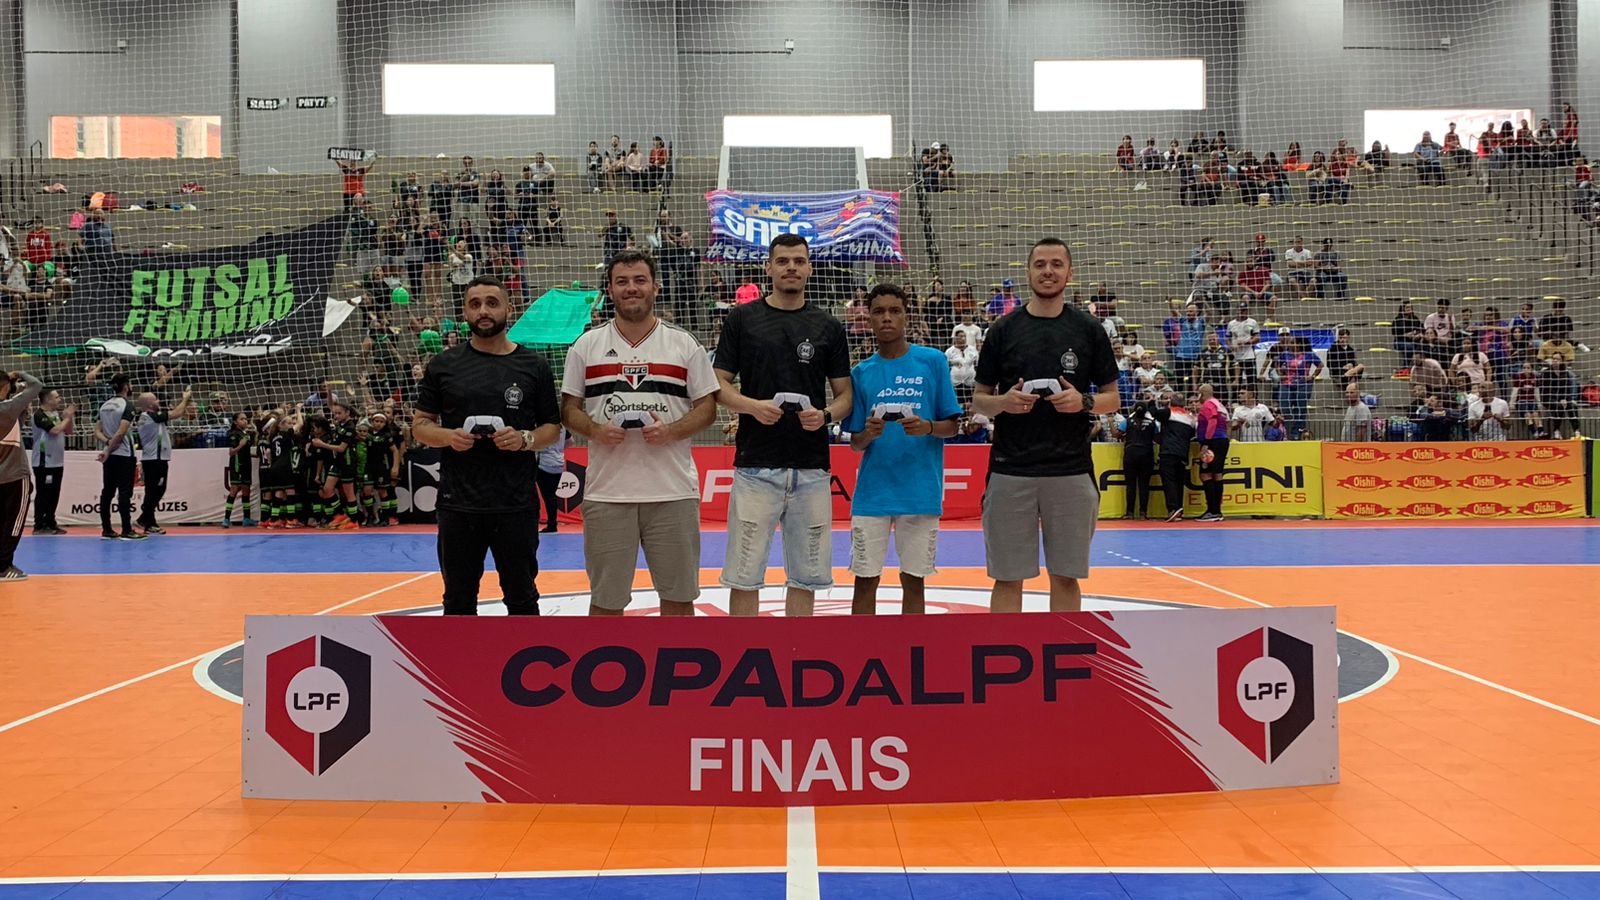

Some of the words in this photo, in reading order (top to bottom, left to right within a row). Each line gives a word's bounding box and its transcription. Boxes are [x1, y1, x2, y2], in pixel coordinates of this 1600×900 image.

[131, 254, 292, 309] FUTSAL
[122, 292, 295, 341] FEMININO
[624, 366, 647, 374] SPFC
[1352, 449, 1375, 459] Oishii
[1412, 449, 1434, 459] Oishii
[1472, 448, 1494, 458] Oishii
[1531, 447, 1553, 458] Oishii
[1353, 477, 1376, 487] Oishii
[1413, 477, 1435, 487] Oishii
[1473, 476, 1495, 486] Oishii
[1532, 475, 1555, 485] Oishii
[1188, 493, 1307, 505] EPORTES
[71, 503, 104, 514] MOG
[111, 503, 137, 513] DS
[1353, 504, 1375, 514] Oishii
[1413, 504, 1436, 514] Oishii
[1473, 504, 1496, 514] Oishii
[1533, 502, 1556, 513] Oishii
[1244, 682, 1287, 701] LPF
[293, 692, 341, 711] LPF
[690, 736, 911, 793] FINAIS
